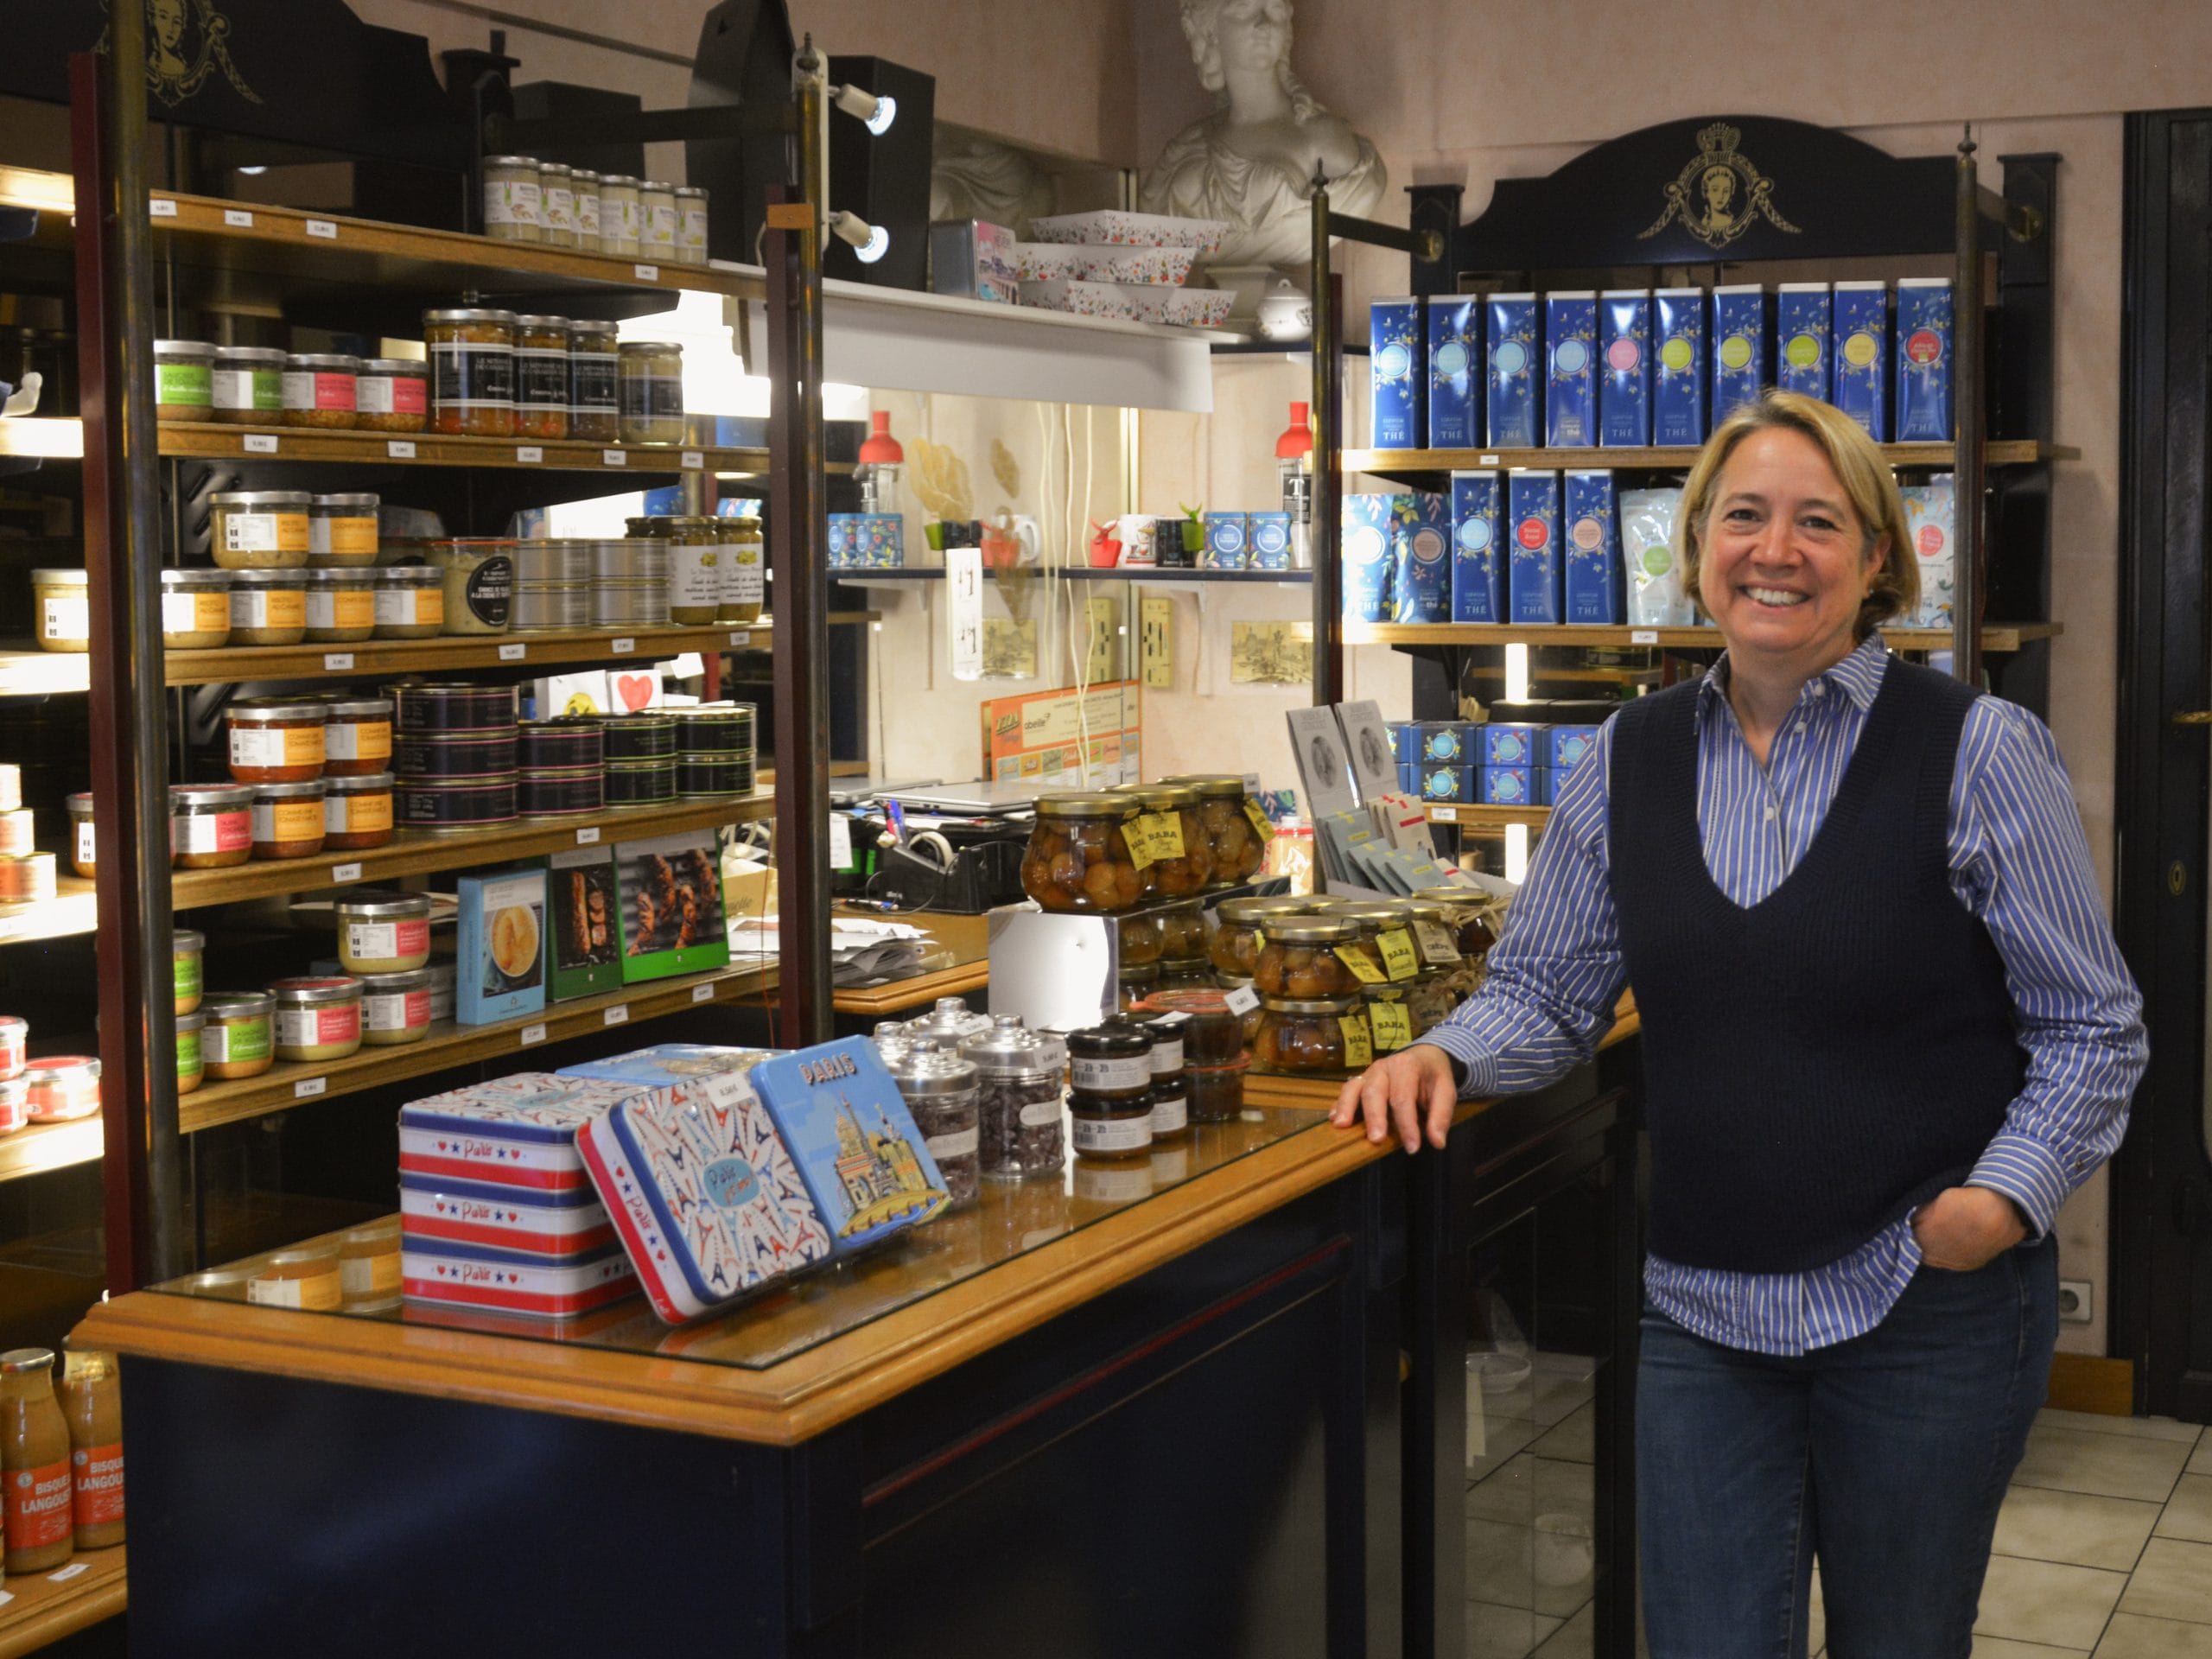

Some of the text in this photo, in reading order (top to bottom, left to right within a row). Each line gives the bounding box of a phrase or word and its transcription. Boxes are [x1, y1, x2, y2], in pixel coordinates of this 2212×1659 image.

[1382, 429, 1405, 441] THÉ
[1465, 605, 1487, 614] THÉ
[1577, 606, 1599, 615] THÉ
[1147, 830, 1178, 841] BABA
[1376, 1020, 1406, 1030] BABA
[798, 1052, 857, 1085] PARIS
[463, 1140, 493, 1158] Paris
[461, 1201, 490, 1220] Paris
[626, 1197, 653, 1231] Paris
[462, 1263, 491, 1282] Paris
